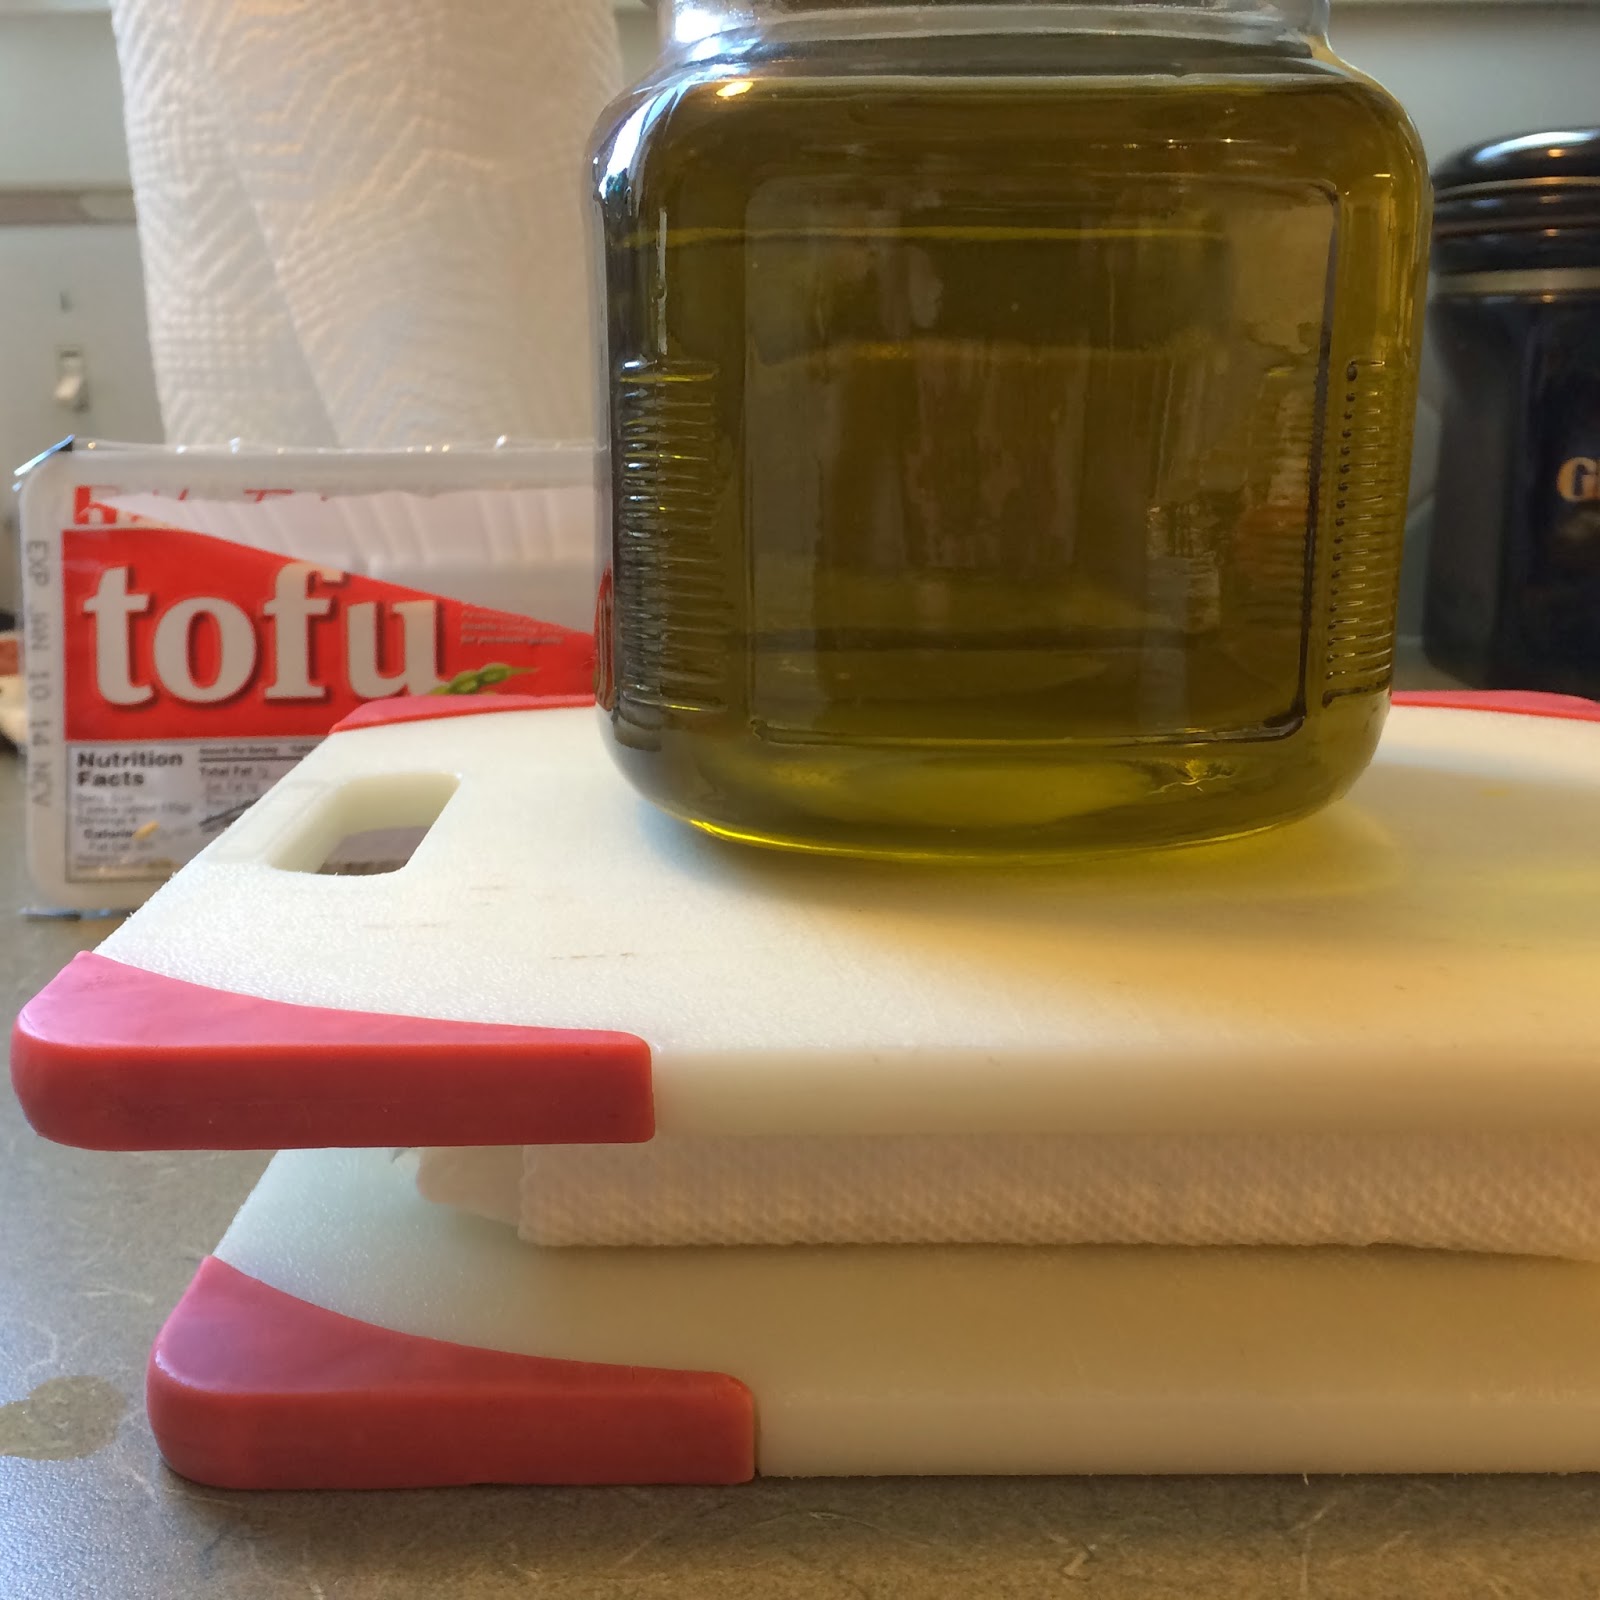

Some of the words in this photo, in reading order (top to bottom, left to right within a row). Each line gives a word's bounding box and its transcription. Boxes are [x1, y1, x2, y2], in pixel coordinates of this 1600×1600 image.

[28, 540, 50, 587] EXP
[83, 561, 450, 706] tofu
[28, 671, 51, 702] 10
[77, 750, 183, 768] Nutrition
[77, 770, 145, 787] Facts
